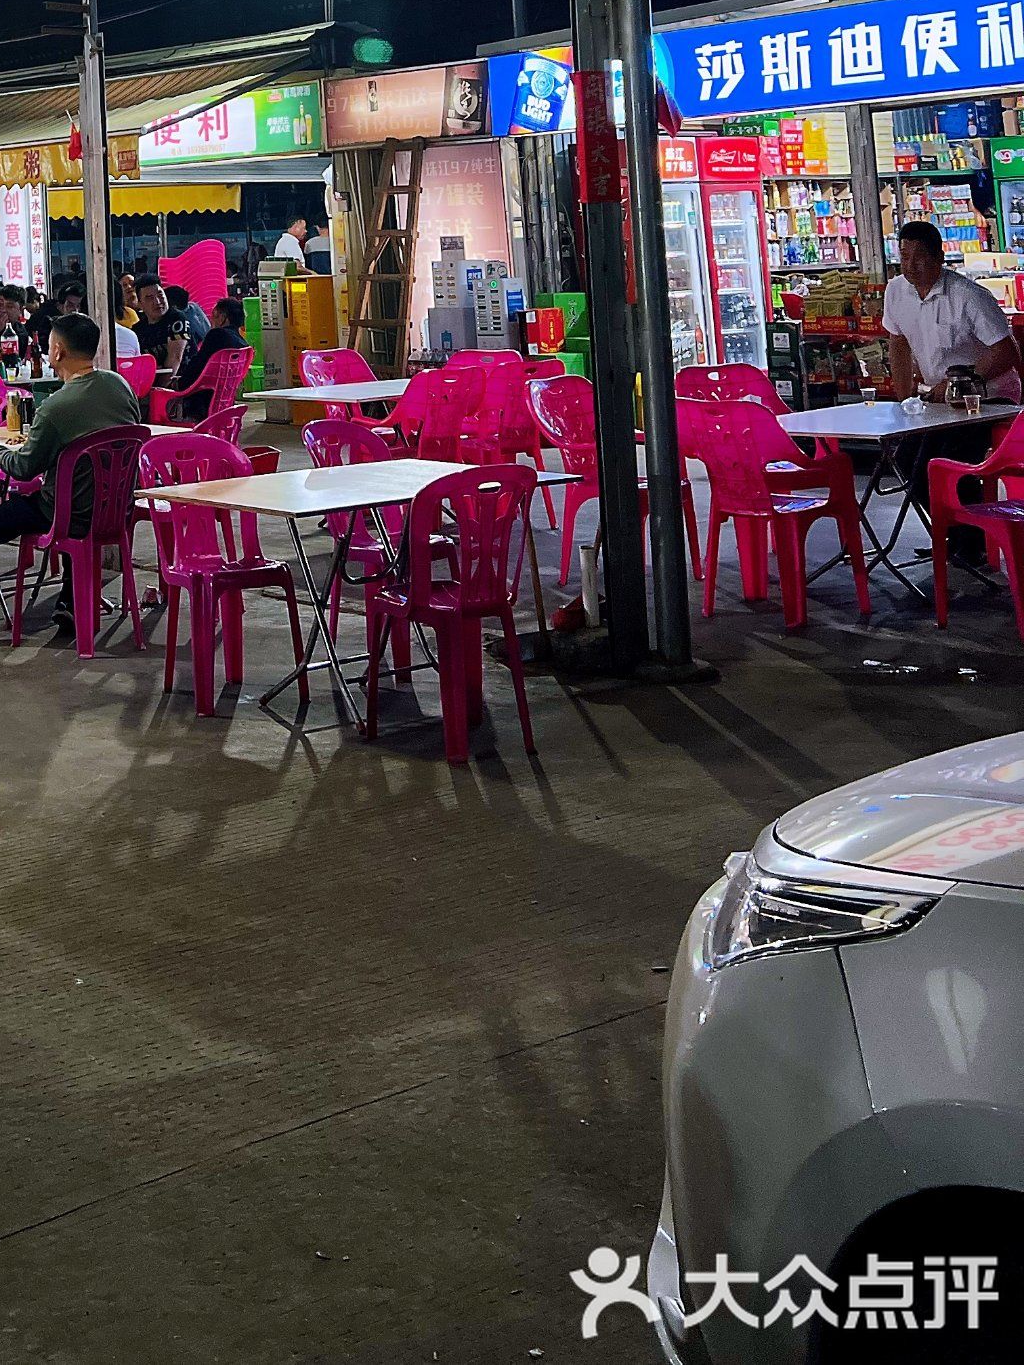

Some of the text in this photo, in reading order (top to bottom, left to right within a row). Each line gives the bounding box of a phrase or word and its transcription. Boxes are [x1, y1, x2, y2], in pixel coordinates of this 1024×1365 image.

[694, 0, 1024, 102] 莎斯迪便利
[521, 105, 554, 123] LIGHT
[526, 95, 551, 110] BUD
[151, 103, 230, 147] 便利
[424, 156, 498, 177] 珠江97纯生
[3, 190, 24, 281] 创意便
